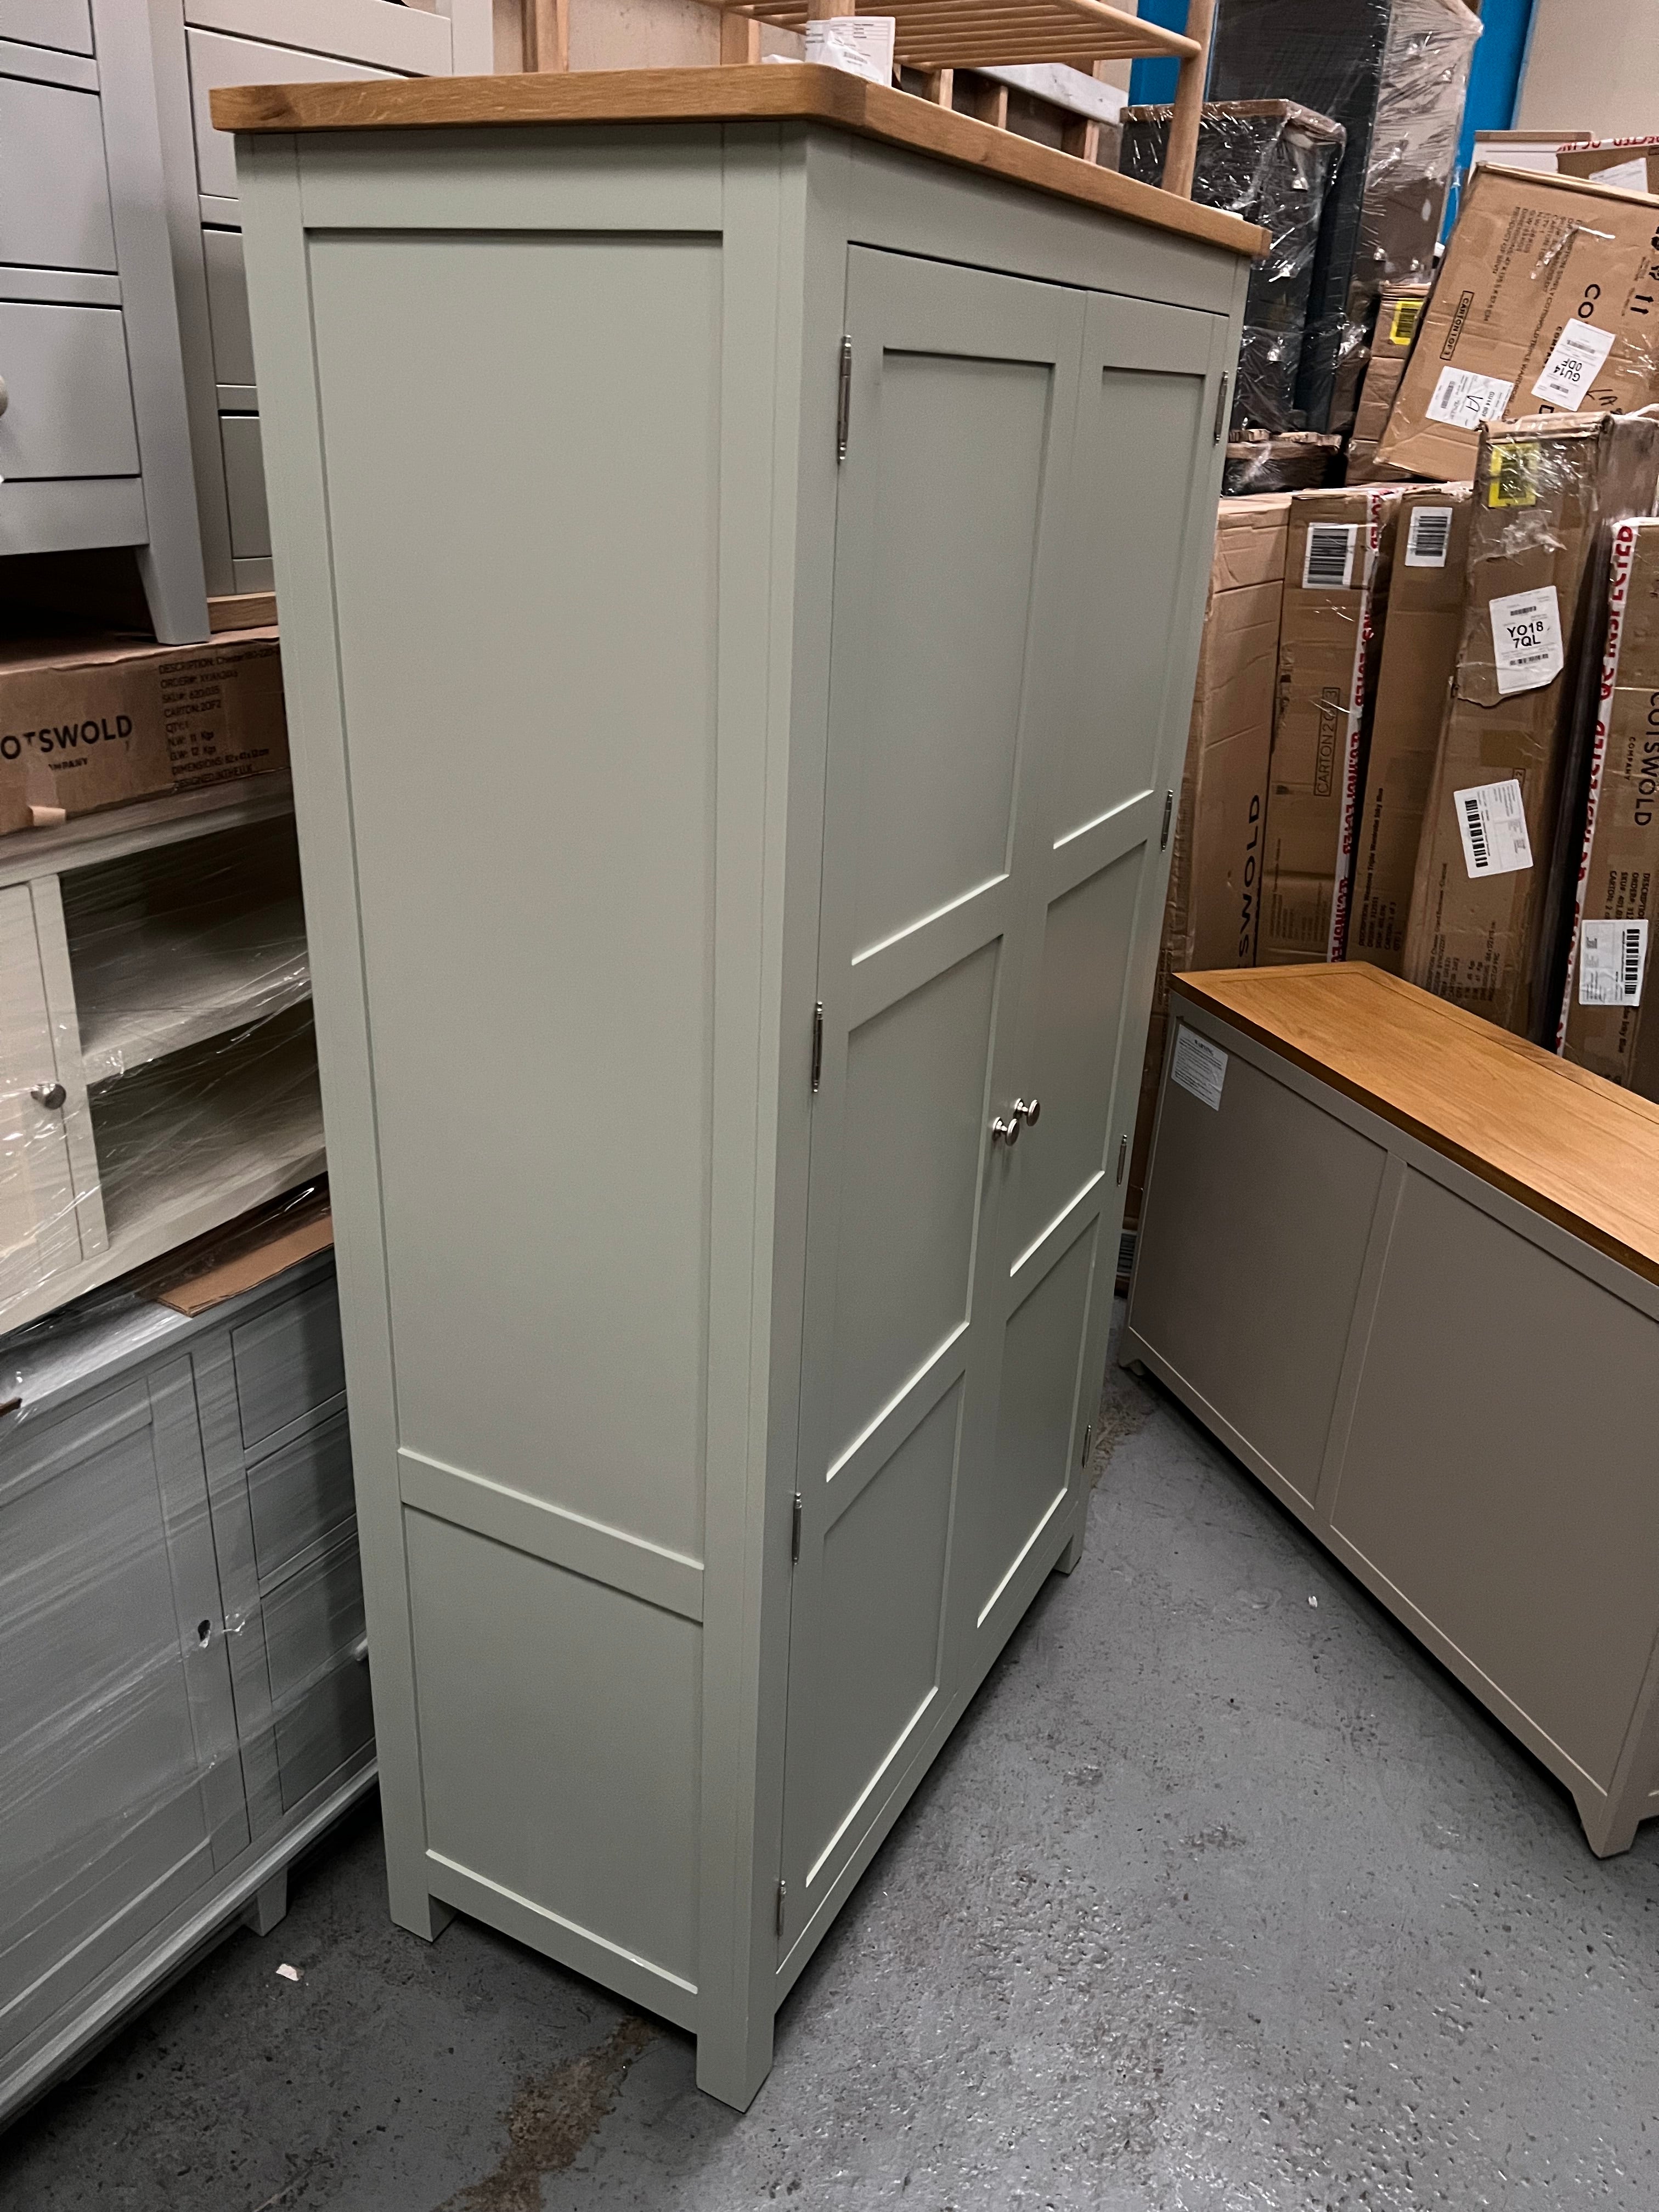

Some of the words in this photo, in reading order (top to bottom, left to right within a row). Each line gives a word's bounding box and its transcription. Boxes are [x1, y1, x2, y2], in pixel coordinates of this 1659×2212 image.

[1452, 296, 1469, 332] CARTON
[1446, 337, 1455, 349] OF
[1553, 365, 1581, 382] GU14
[1485, 391, 1495, 407] GU14
[1506, 620, 1544, 638] YO18
[1512, 634, 1541, 648] 7QL
[1322, 723, 1334, 732] 2
[0, 715, 132, 760] OTSWOLD
[1316, 734, 1333, 794] CARTON
[1623, 737, 1636, 781] COMPANY
[1239, 795, 1260, 957] SWOLD
